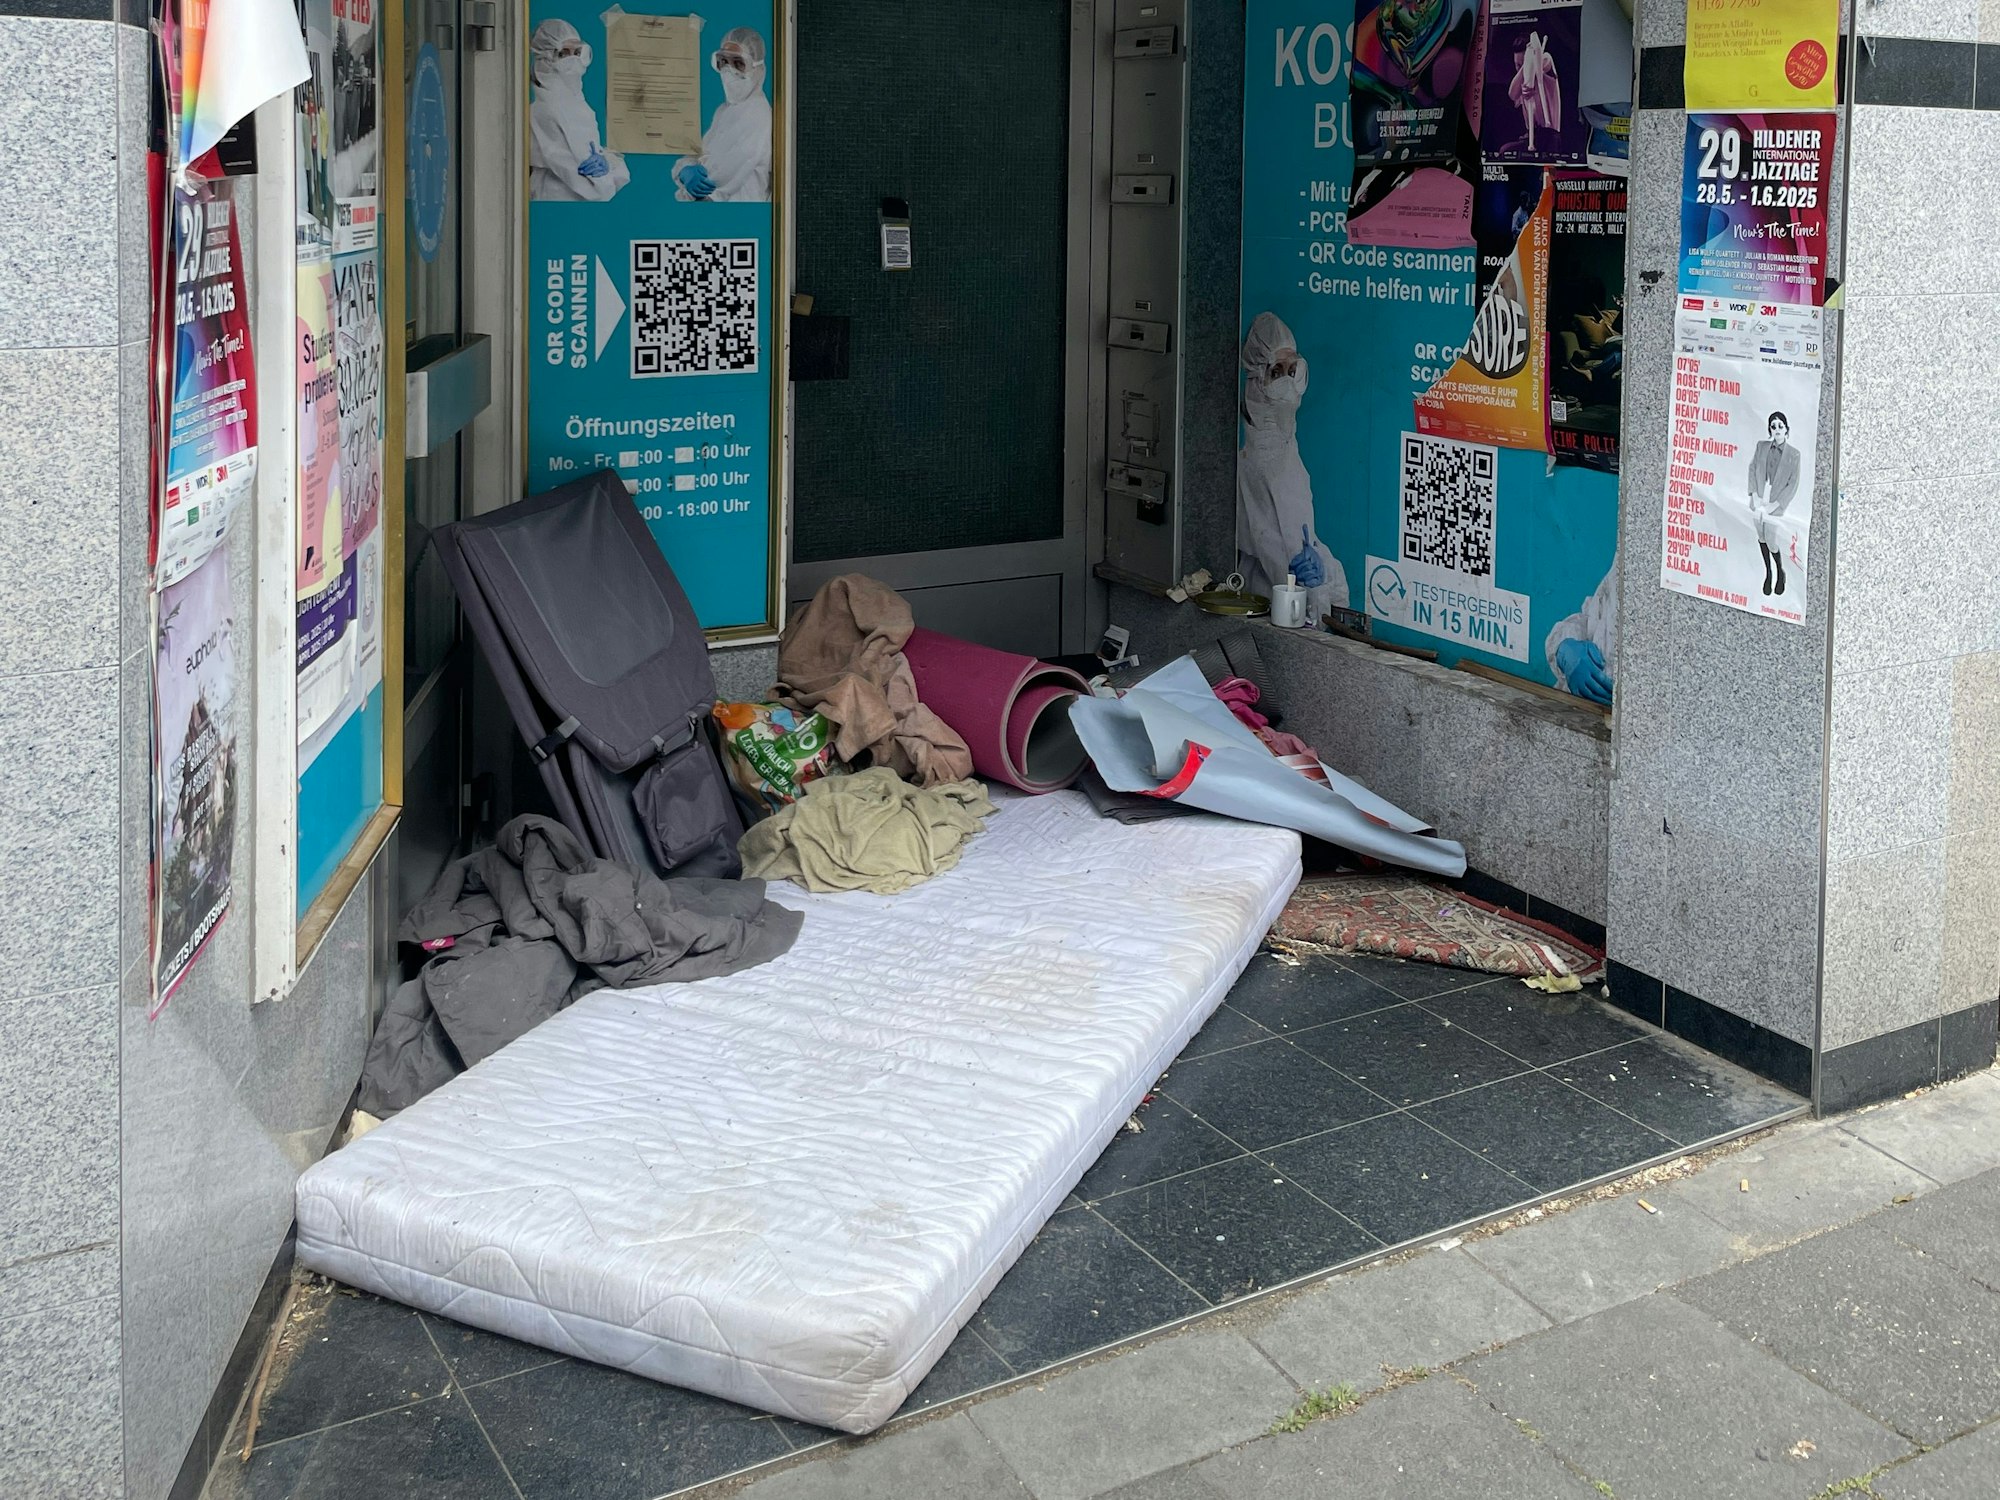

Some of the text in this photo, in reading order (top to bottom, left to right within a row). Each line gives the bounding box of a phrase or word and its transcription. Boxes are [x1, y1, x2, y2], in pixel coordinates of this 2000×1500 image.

[1748, 85, 1758, 97] G
[1753, 129, 1821, 149] HILDENER
[1697, 127, 1748, 181] 29.
[1752, 150, 1820, 161] INTERNATIONAL
[1750, 162, 1819, 181] JAZZTAGE
[1310, 181, 1336, 202] Mit
[1557, 192, 1601, 211] AMUSING
[1696, 184, 1736, 205] 28.5.
[1750, 185, 1818, 208] 1.6.2025
[1462, 194, 1471, 220] TANZ
[1733, 221, 1820, 241] Now's The Time!
[1309, 242, 1476, 273] QR Code scannen
[1716, 249, 1740, 259] QUARTETT
[1744, 251, 1763, 260] JULIAN
[1758, 263, 1785, 273] SEBASTIAN
[1308, 272, 1360, 297] Gerne
[1366, 276, 1422, 302] helfen
[1428, 282, 1460, 305] wir
[201, 282, 236, 319] 1.6.2025
[1729, 303, 1747, 312] WDR
[1760, 305, 1777, 316] 3M
[547, 259, 564, 365] QR CODE
[570, 254, 587, 369] SCANNEN
[1415, 343, 1436, 360] QR
[1806, 343, 1818, 353] RP
[1438, 381, 1518, 398] ARTS ENSEMBLE RUHR
[1676, 373, 1740, 396] ROSE CITY BAND
[1426, 400, 1445, 410] CUBA
[1675, 403, 1729, 426] HEAVY LUNGS
[565, 411, 736, 439] Öffnungszeiten
[1673, 431, 1700, 451] GÜNER
[549, 444, 751, 471] Mo. Fr. Uhr
[723, 472, 750, 487] Uhr
[1670, 464, 1714, 485] EUROEURO
[678, 499, 750, 517] 18:00 Uhr
[1668, 495, 1705, 515] NAP EYES
[1667, 525, 1728, 551] MASHA QRELLA
[1666, 556, 1700, 576] S.U.G.A.R.
[1413, 581, 1523, 624] TESTERGEBNIS
[1724, 591, 1729, 601] &
[1731, 593, 1748, 607] SOHN
[1413, 600, 1513, 649] IN 15 MIN.
[194, 885, 232, 947] BOOTSHAUS
